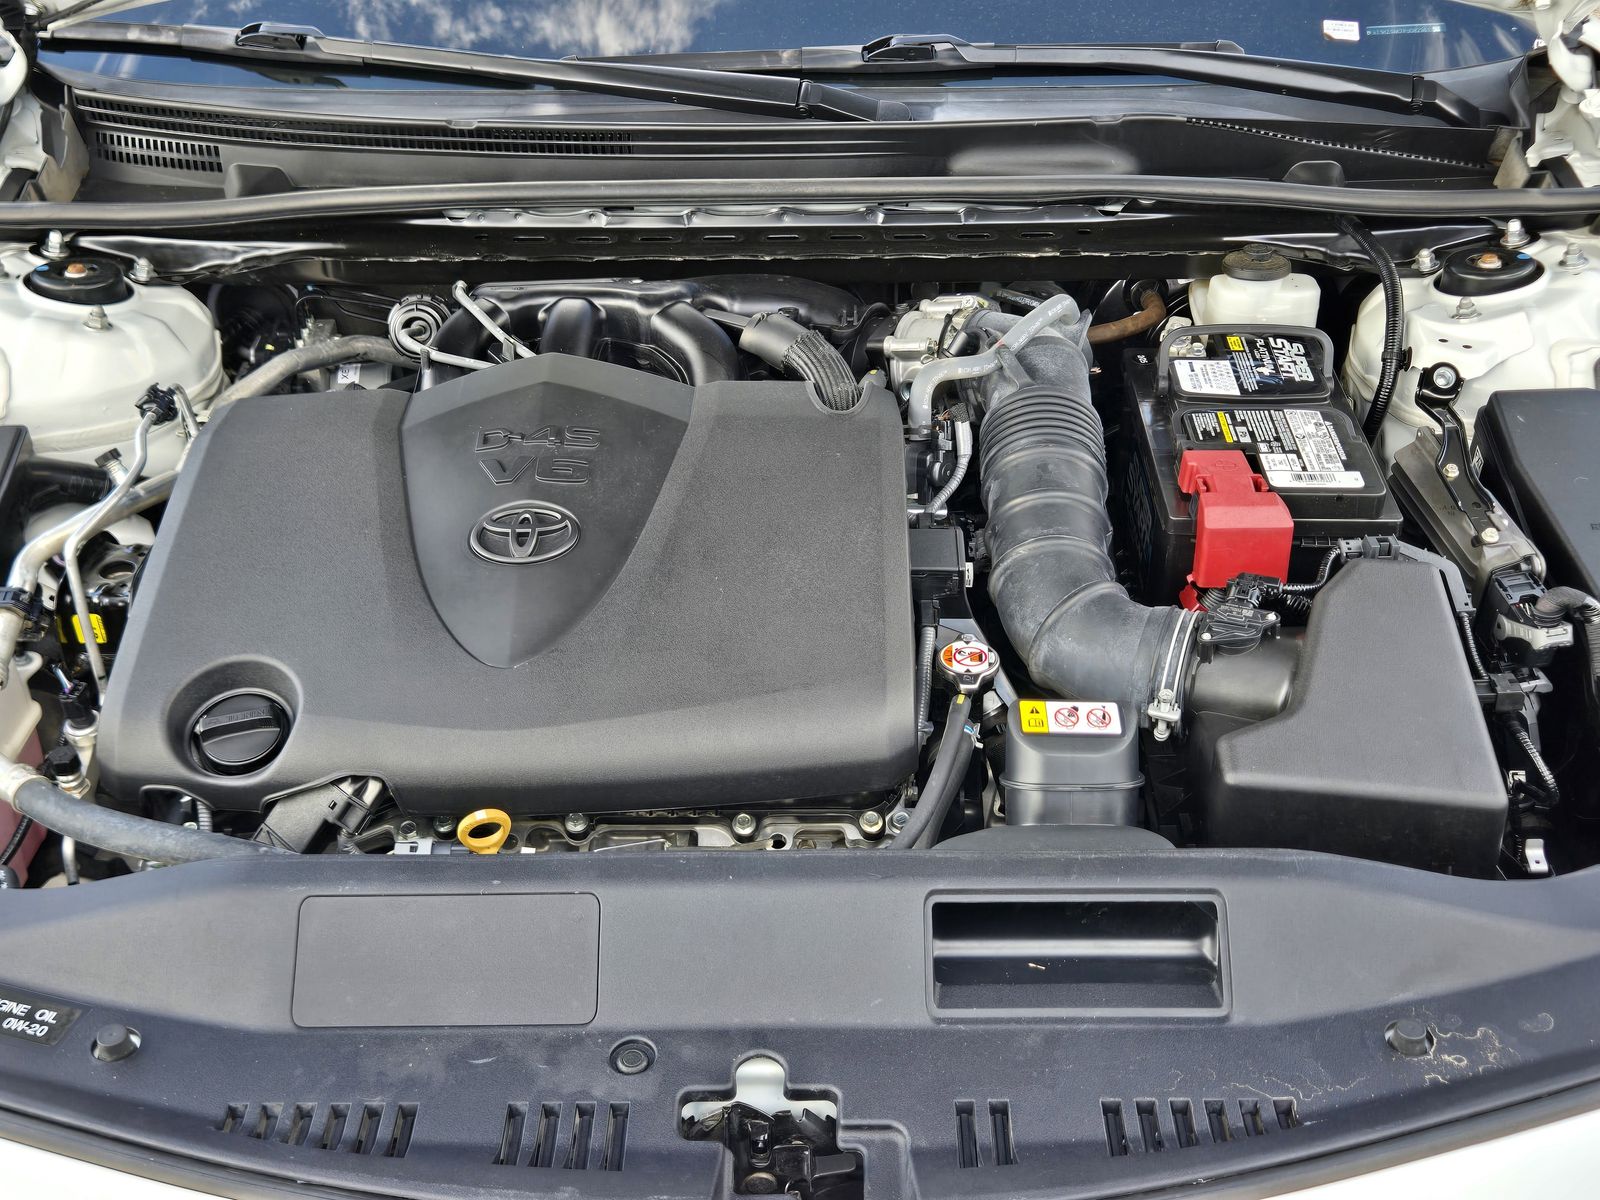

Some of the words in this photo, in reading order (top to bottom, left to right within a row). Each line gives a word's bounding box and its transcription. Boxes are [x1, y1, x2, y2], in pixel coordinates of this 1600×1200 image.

[1268, 337, 1301, 382] START
[1287, 342, 1315, 382] SUPER
[474, 424, 600, 453] D-4S
[479, 454, 590, 486] V6
[0, 998, 32, 1017] GINE
[34, 1008, 58, 1025] OIL
[1, 1017, 49, 1038] 0W-20
